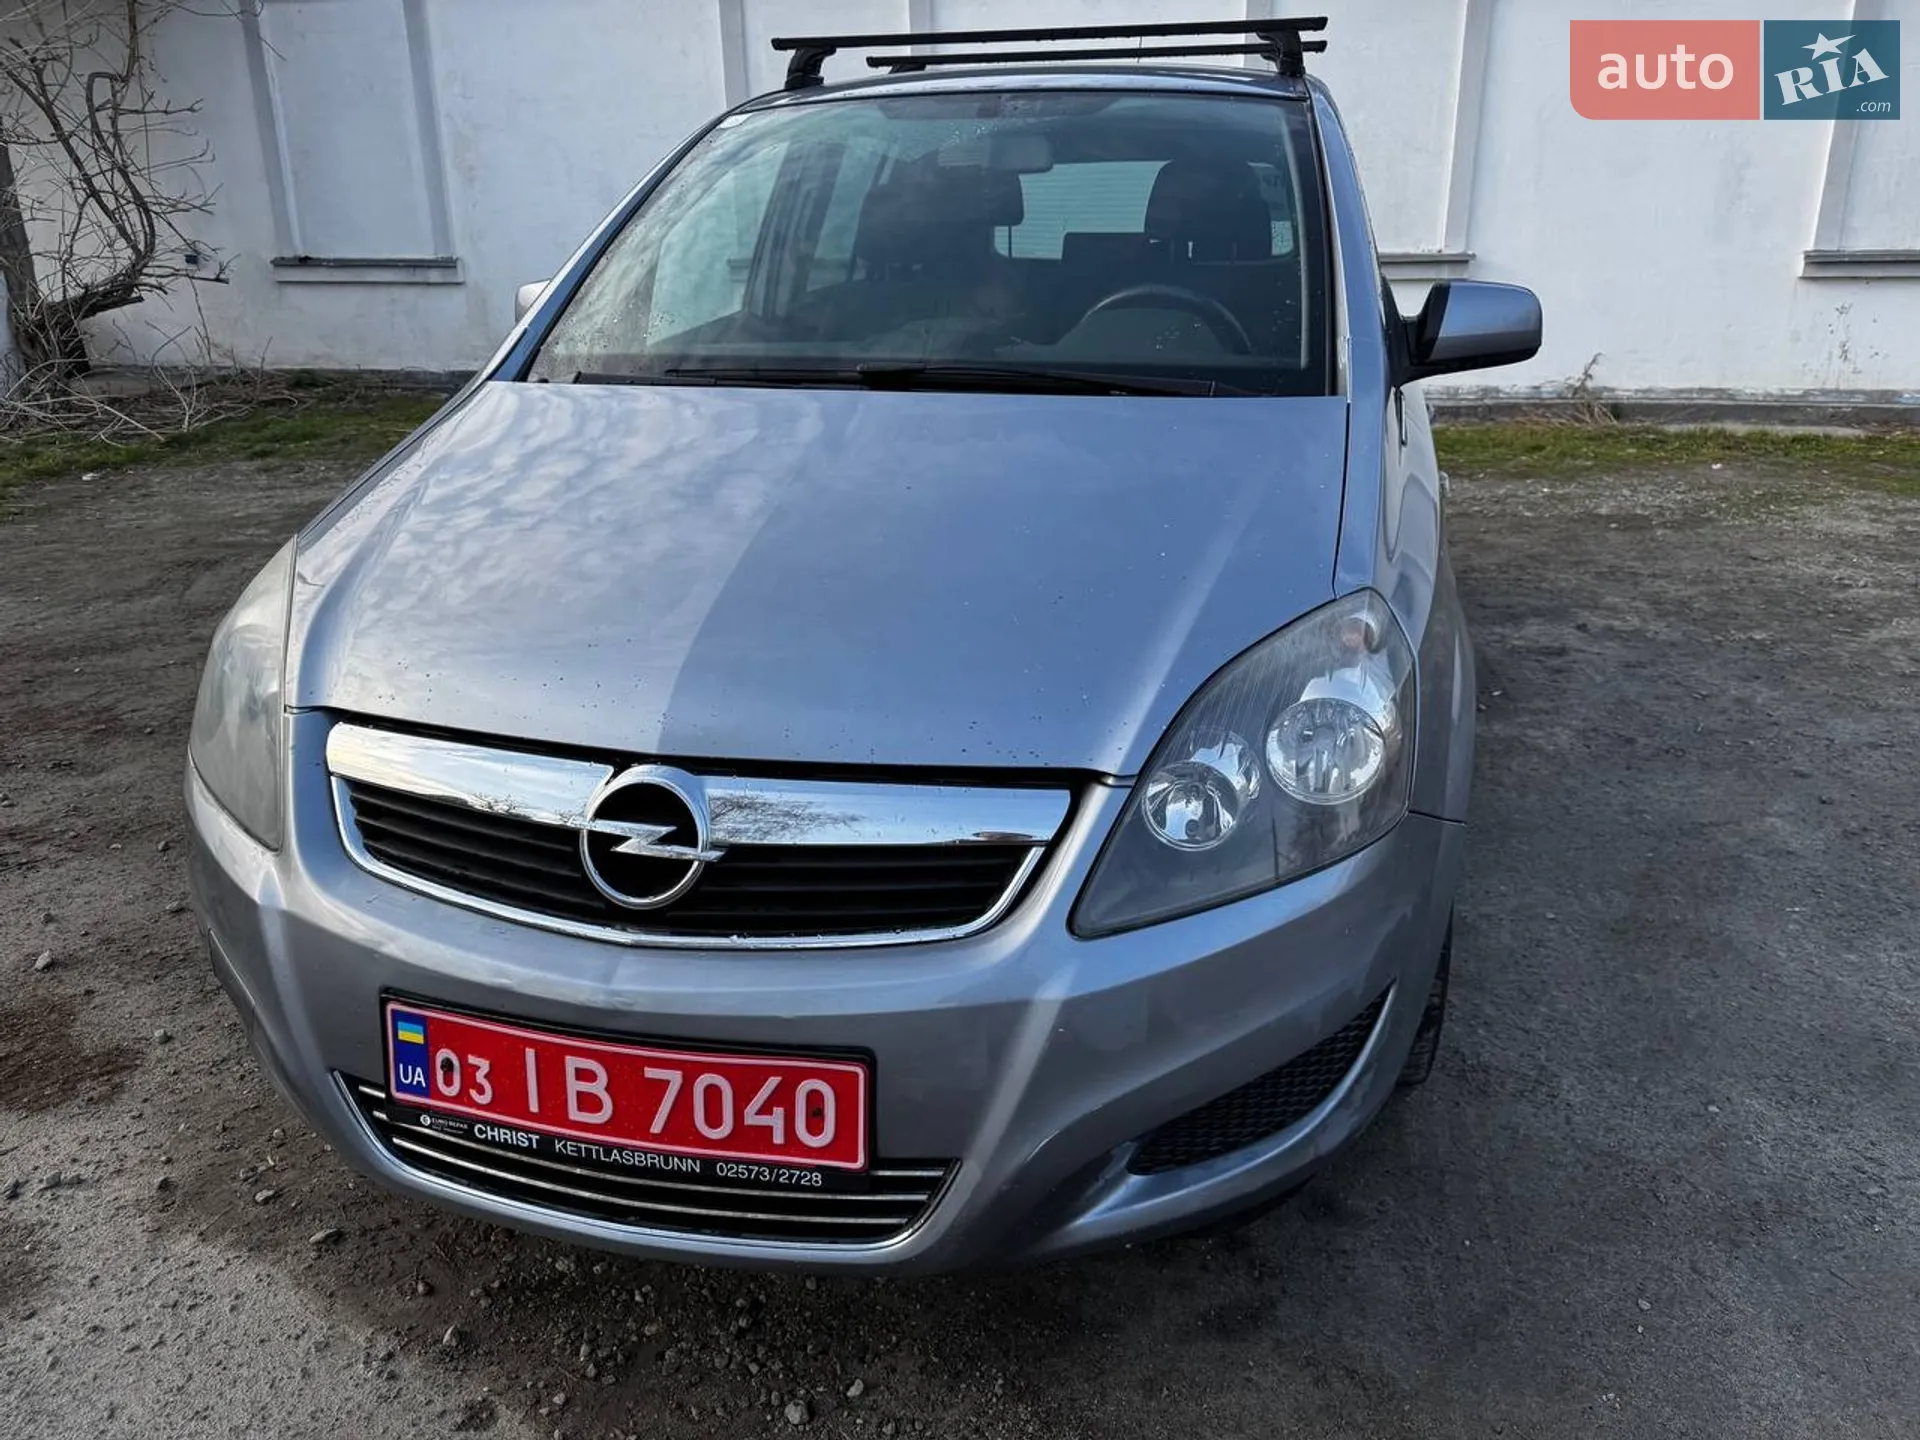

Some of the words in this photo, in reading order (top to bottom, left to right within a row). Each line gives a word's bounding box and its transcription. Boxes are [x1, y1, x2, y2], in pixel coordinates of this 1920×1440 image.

[399, 1063, 426, 1088] UA
[435, 1048, 493, 1105] 03
[643, 1067, 836, 1148] 7040
[474, 1124, 540, 1149] CHRIST
[554, 1139, 700, 1173] KETTLASBRUNN
[716, 1162, 822, 1187] 02573/2728
